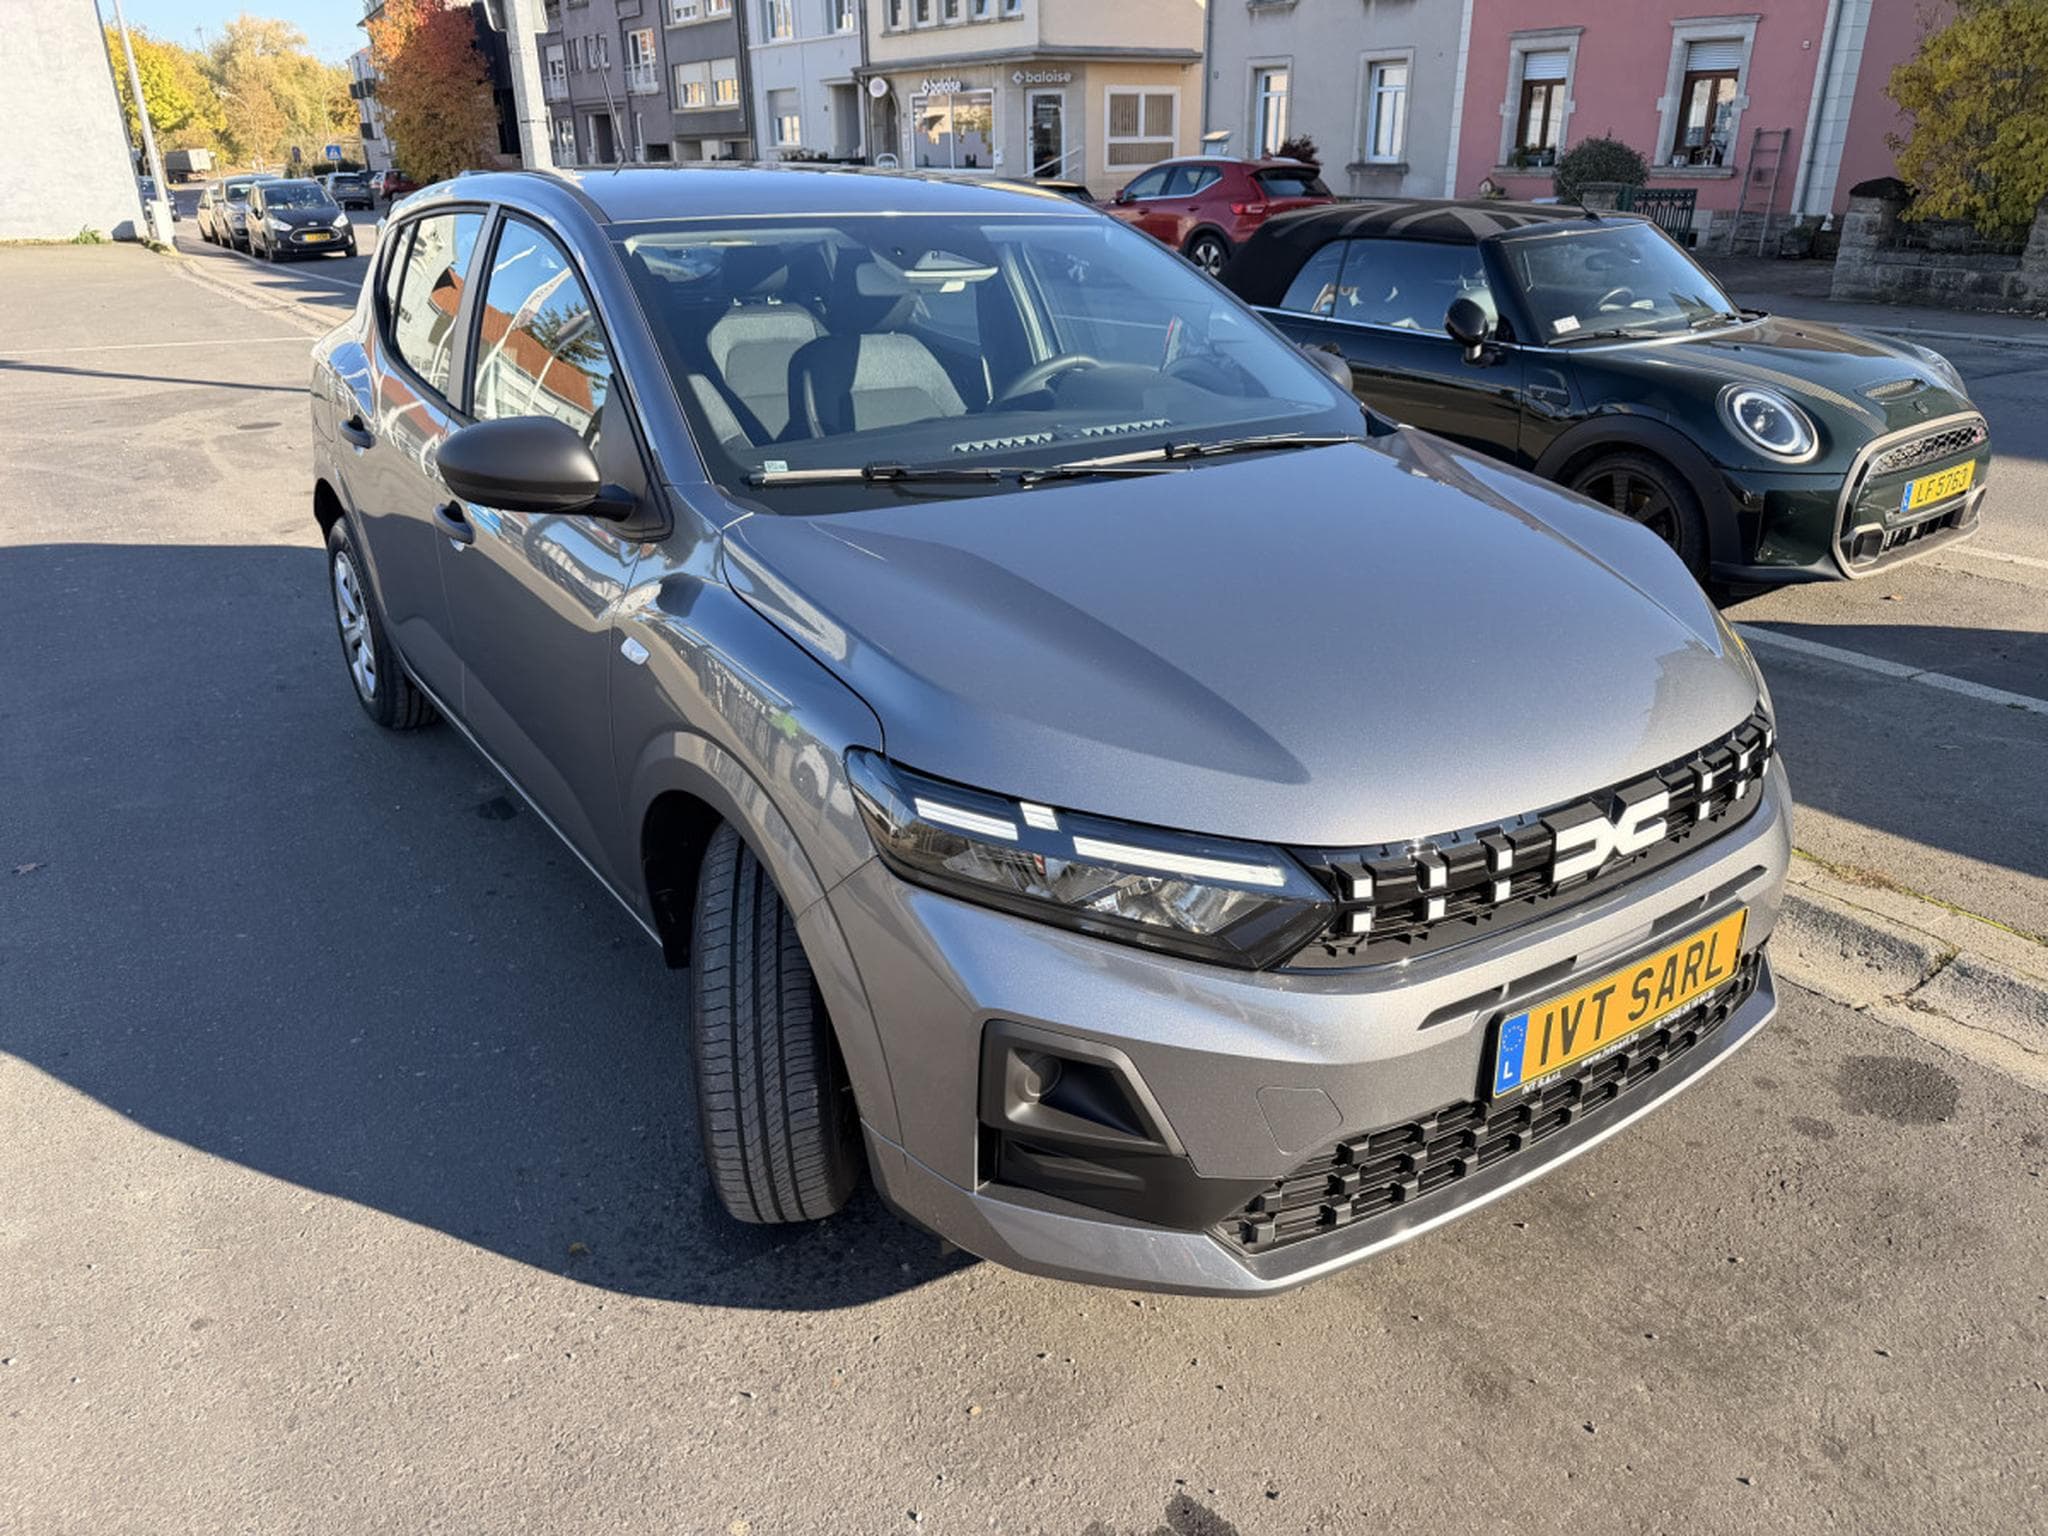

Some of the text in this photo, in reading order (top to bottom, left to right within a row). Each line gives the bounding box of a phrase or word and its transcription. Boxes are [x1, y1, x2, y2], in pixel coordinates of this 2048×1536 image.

[929, 77, 962, 94] baloise
[1025, 69, 1072, 83] baloise
[1916, 479, 1936, 503] LF
[1540, 983, 1616, 1067] IVT
[1627, 931, 1723, 1022] SARL
[1503, 1060, 1513, 1080] L
